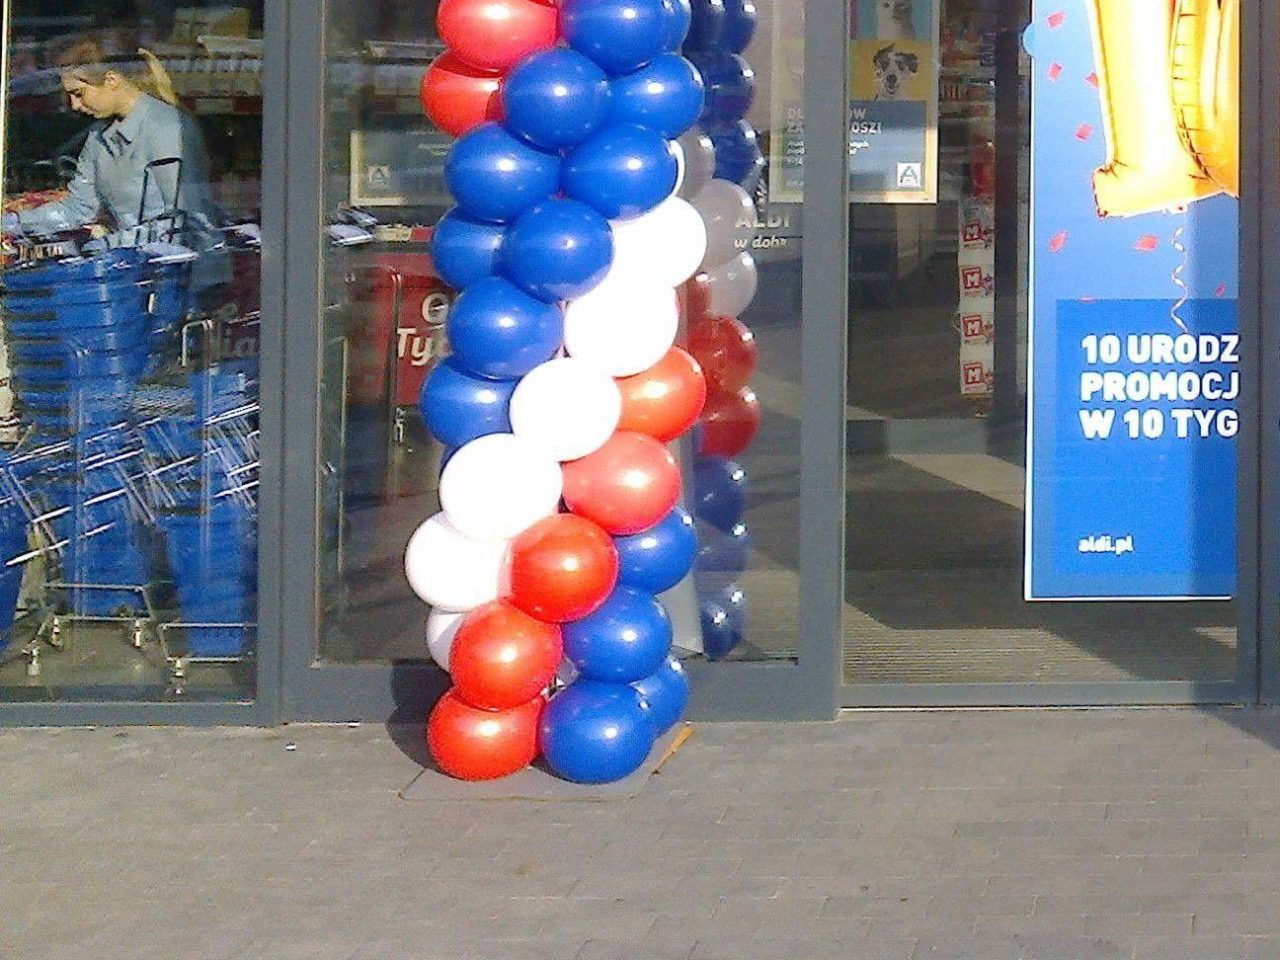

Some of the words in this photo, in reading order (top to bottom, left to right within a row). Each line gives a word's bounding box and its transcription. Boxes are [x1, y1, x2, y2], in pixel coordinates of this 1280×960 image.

[1081, 335, 1120, 363] 10
[1079, 409, 1116, 439] W
[1124, 409, 1164, 439] 10
[1078, 534, 1133, 555] aldi.pl
